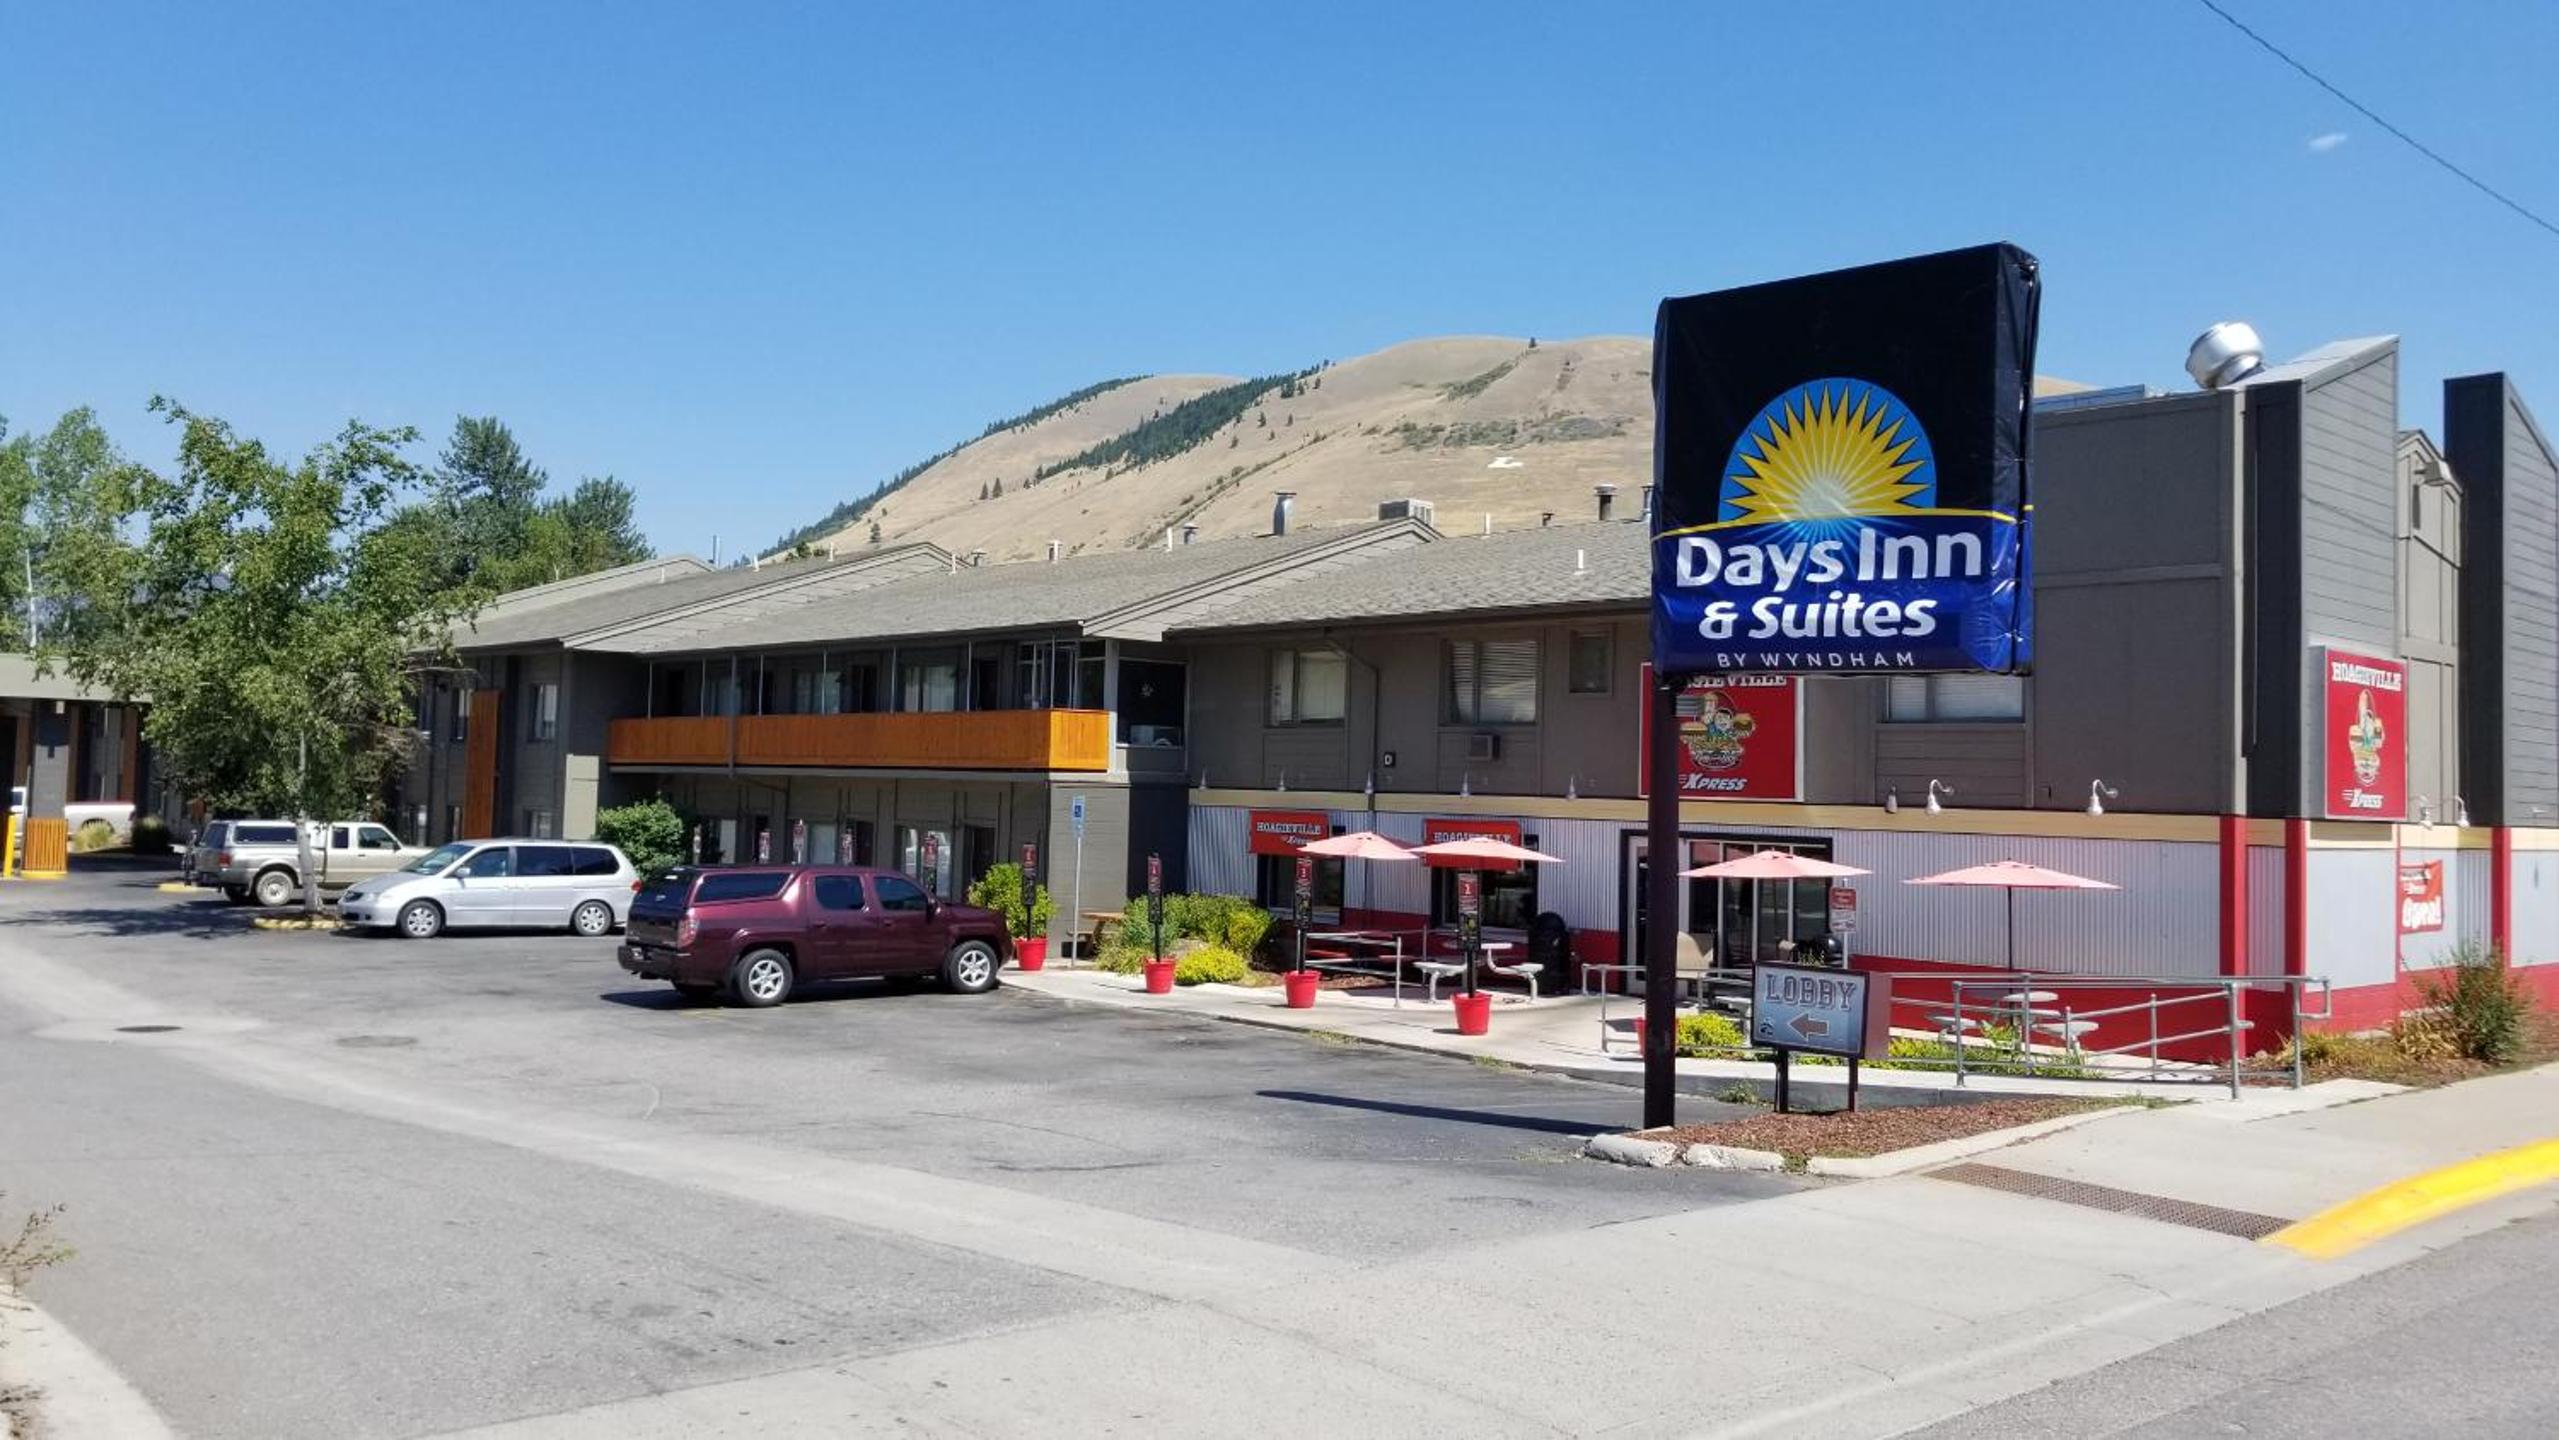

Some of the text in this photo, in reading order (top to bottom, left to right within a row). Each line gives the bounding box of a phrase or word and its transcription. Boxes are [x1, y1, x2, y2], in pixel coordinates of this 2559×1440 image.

[1676, 527, 1982, 592] Days Inn
[1699, 590, 1938, 639] & Suites
[1717, 652, 1915, 668] BY WYNDHAM
[1765, 973, 1857, 1012] LOBBY
